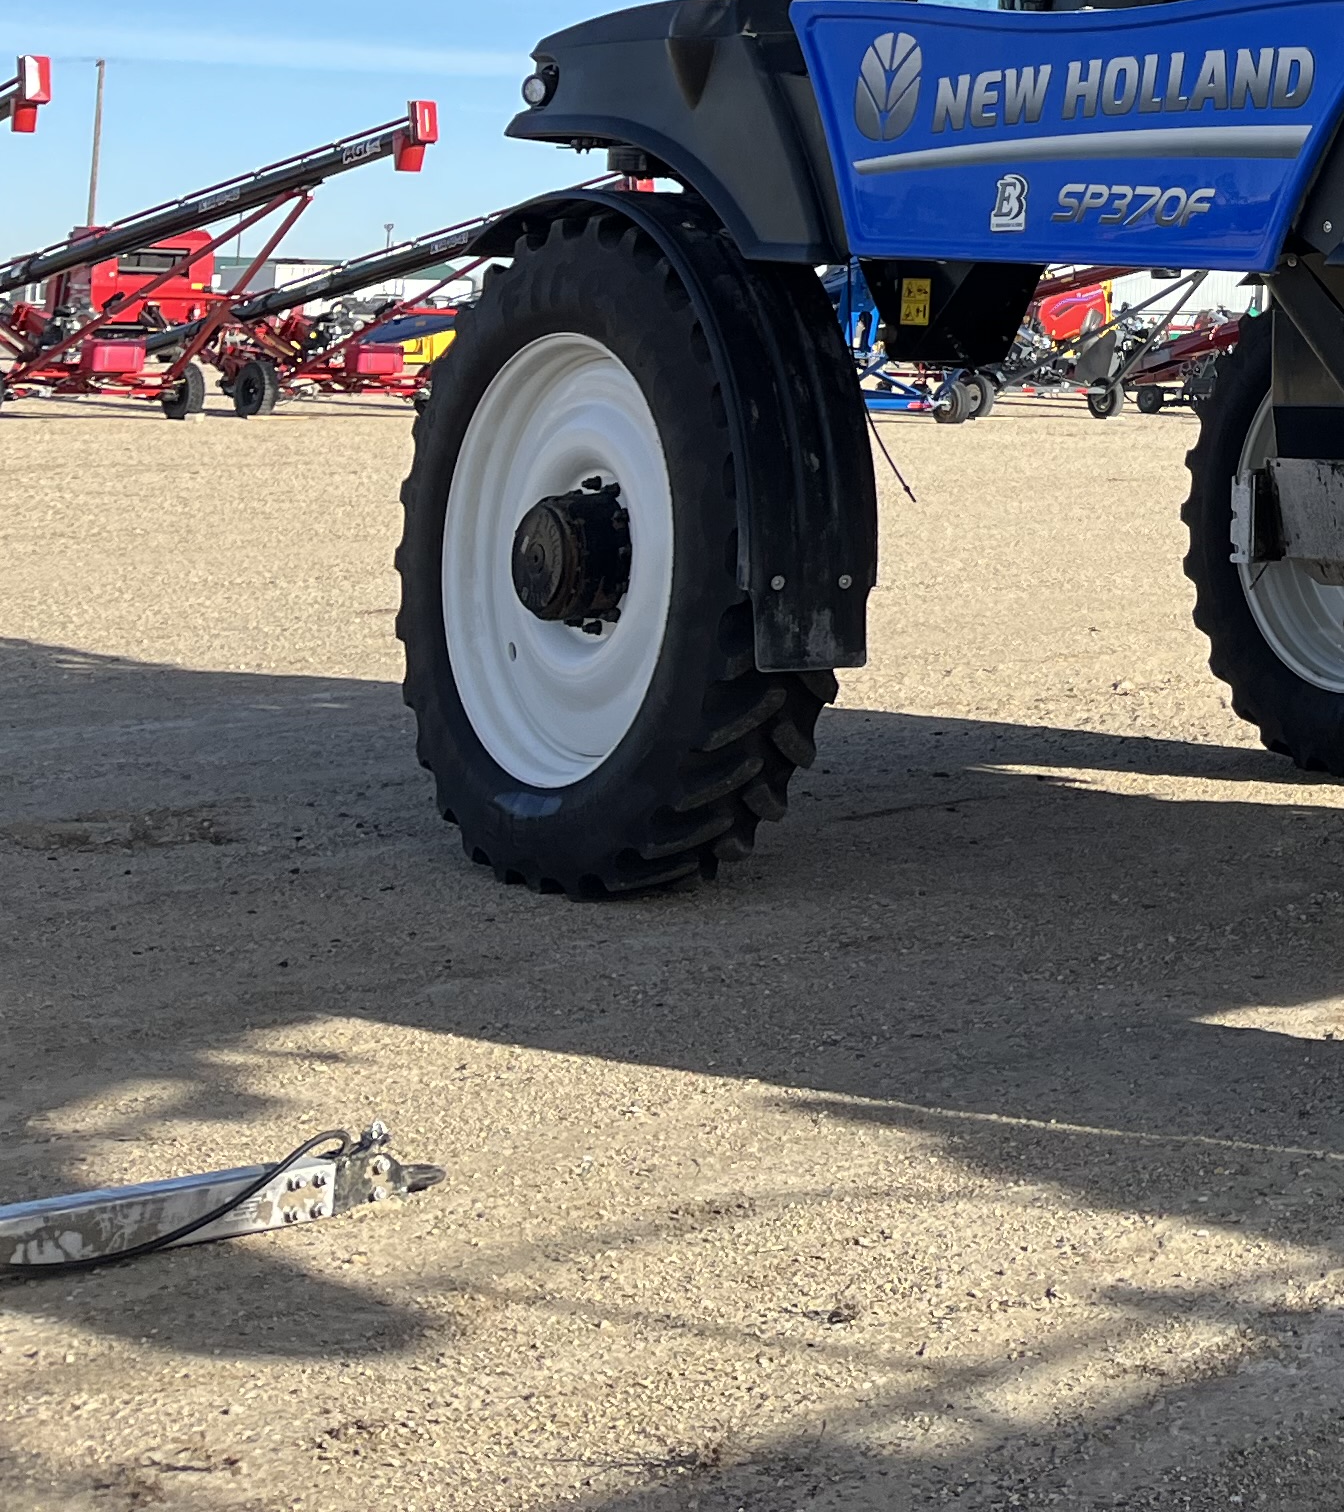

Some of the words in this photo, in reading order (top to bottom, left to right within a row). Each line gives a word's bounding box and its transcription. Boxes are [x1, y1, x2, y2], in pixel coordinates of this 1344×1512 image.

[930, 64, 1052, 134] NEW
[1061, 46, 1316, 120] HOLLAND
[1050, 182, 1217, 228] SP370F
